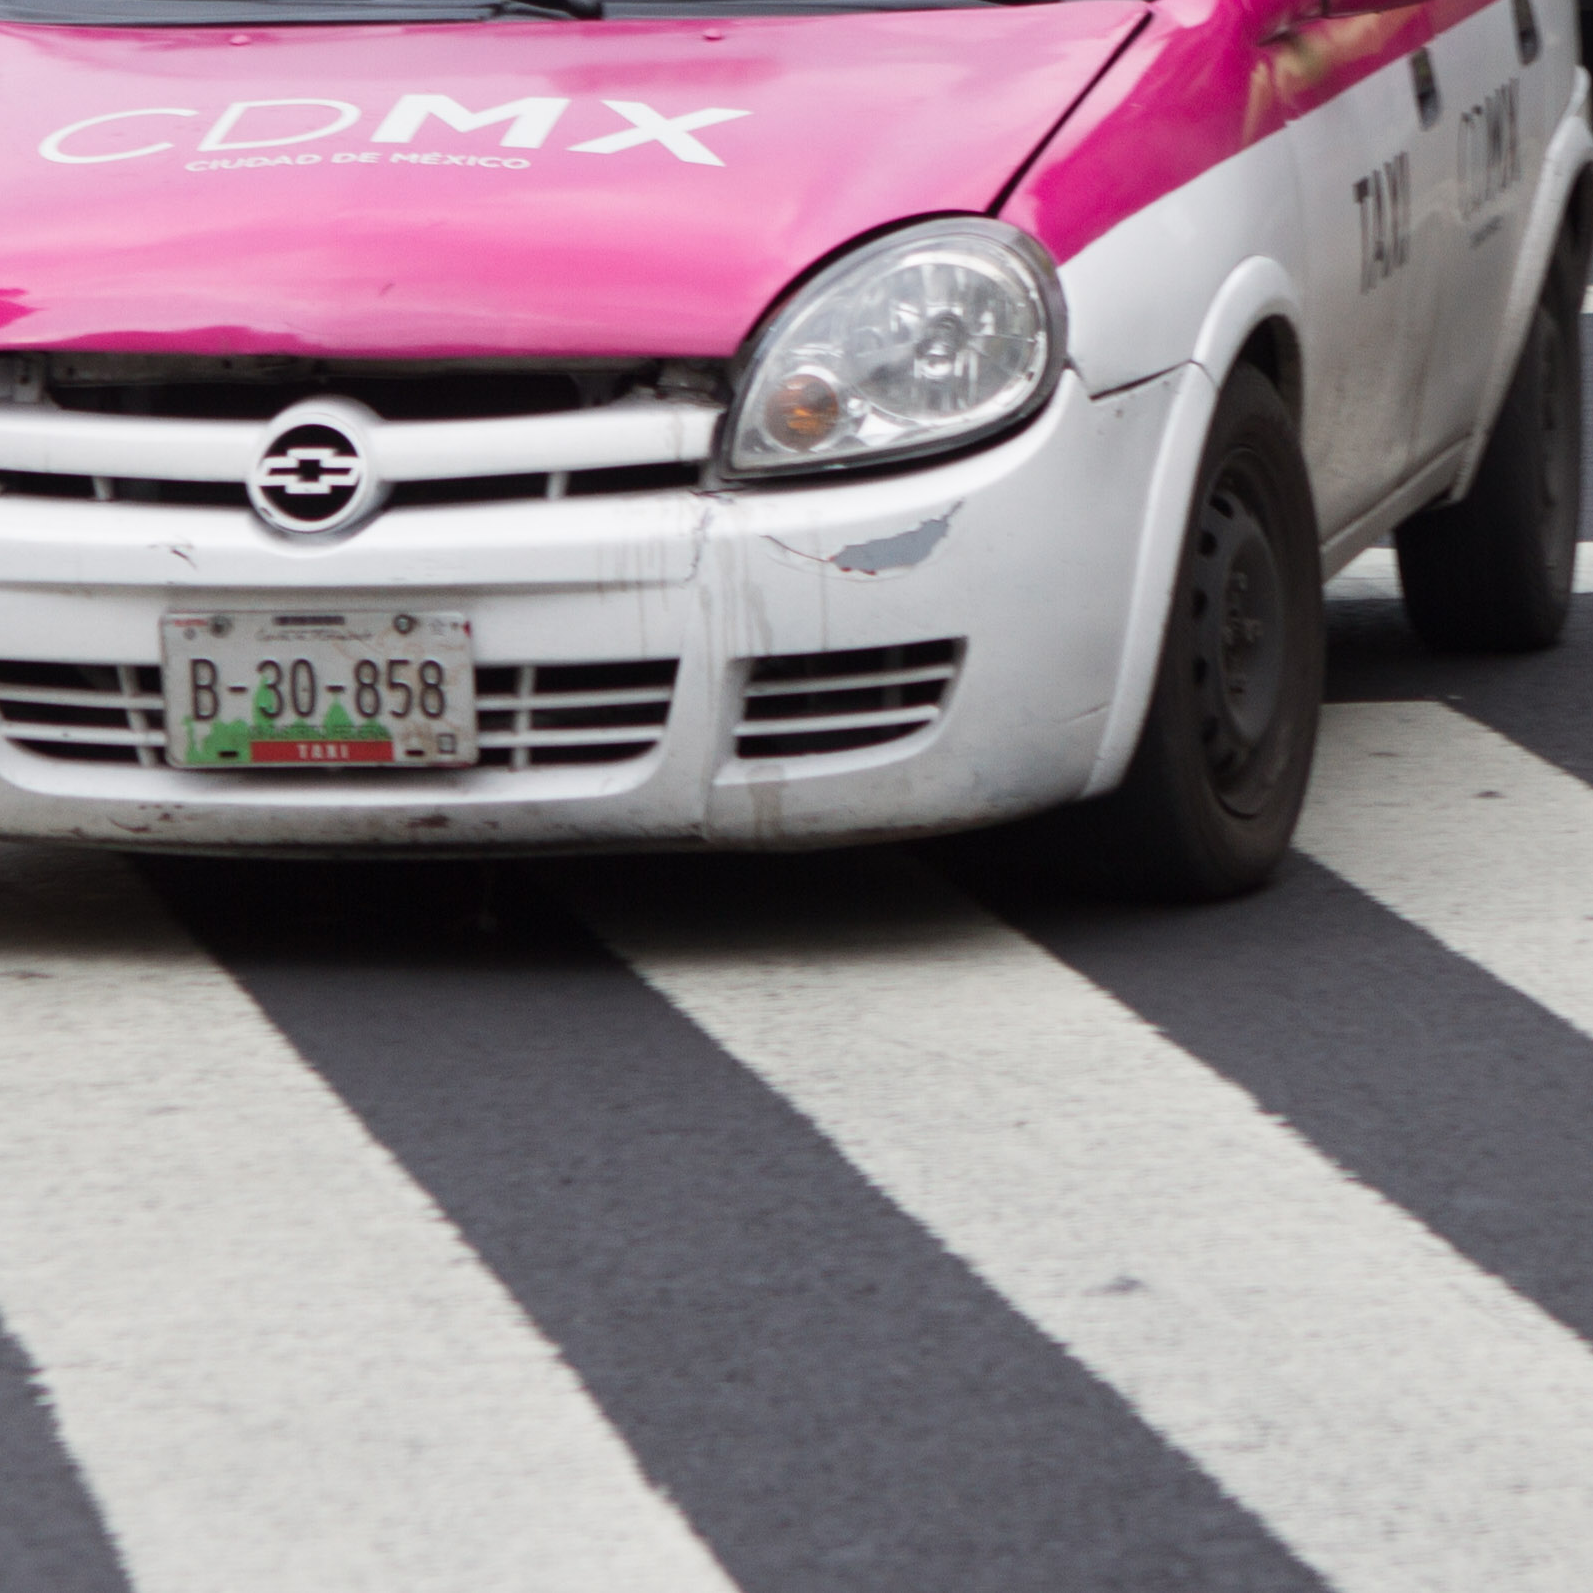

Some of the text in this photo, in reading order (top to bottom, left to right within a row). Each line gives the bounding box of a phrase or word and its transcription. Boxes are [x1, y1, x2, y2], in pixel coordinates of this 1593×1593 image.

[38, 93, 754, 167] CDMX
[184, 150, 531, 172] CIUDAD DE MÉXICO
[1353, 150, 1410, 295] TAXI
[190, 658, 446, 721] B-30-858
[296, 743, 350, 759] TAXI
